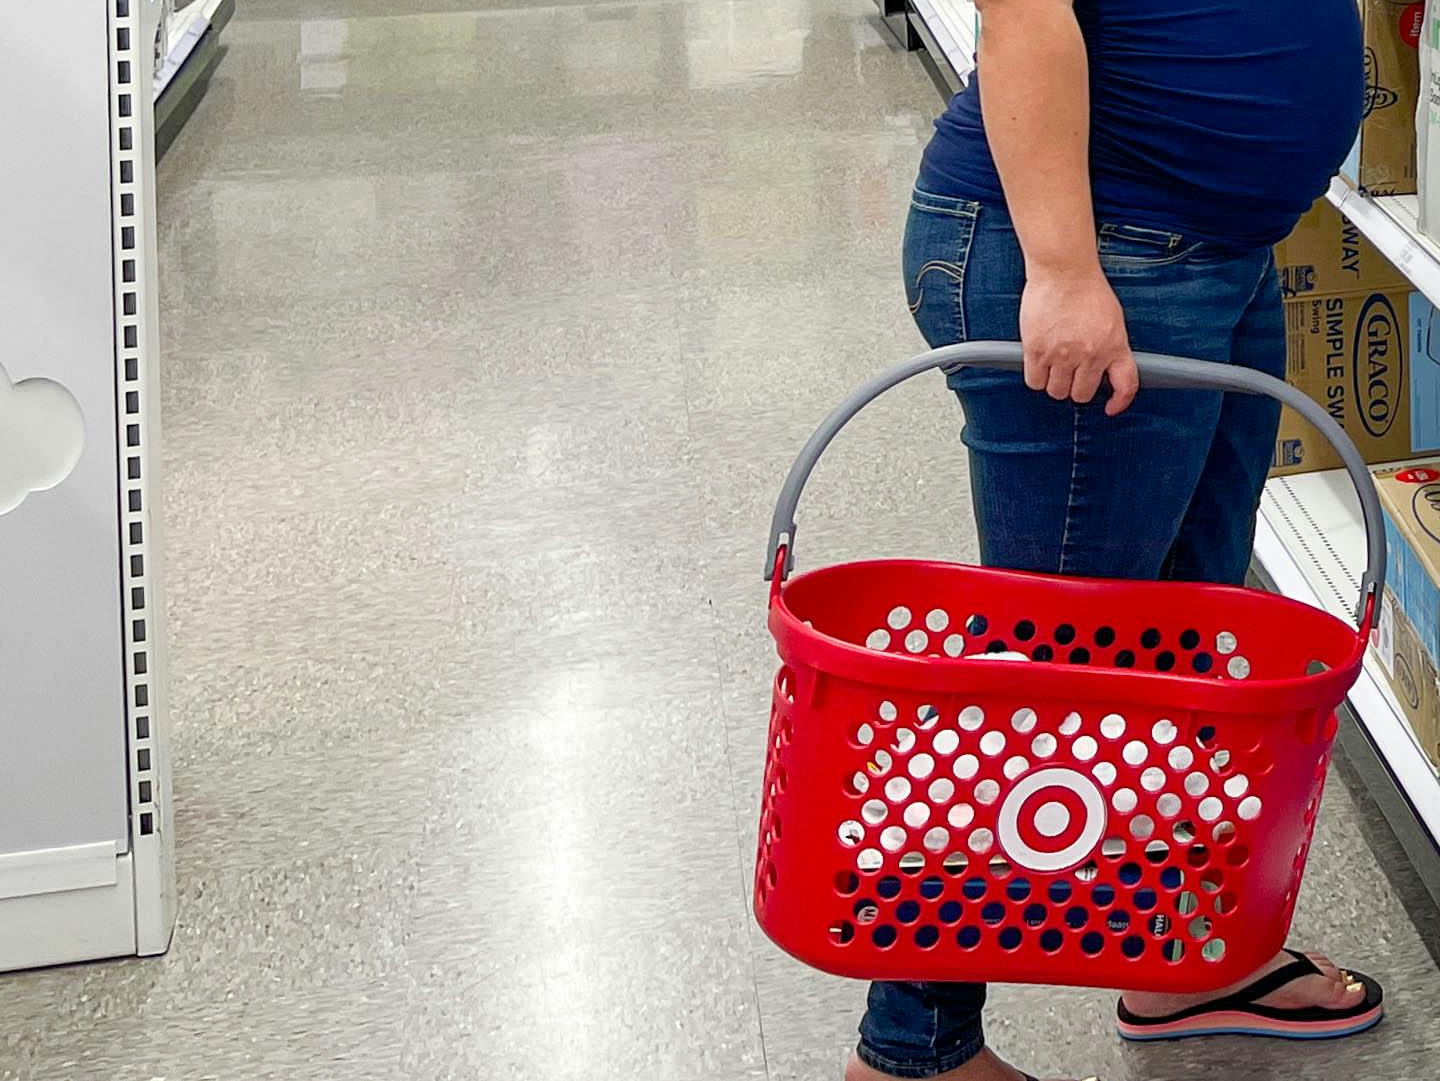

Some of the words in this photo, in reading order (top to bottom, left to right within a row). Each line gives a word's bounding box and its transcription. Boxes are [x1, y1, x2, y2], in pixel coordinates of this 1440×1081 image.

[1310, 299, 1322, 334] Swing
[1326, 297, 1344, 380] SIMPLE
[1366, 314, 1392, 422] GRACO
[1327, 385, 1345, 428] SW
